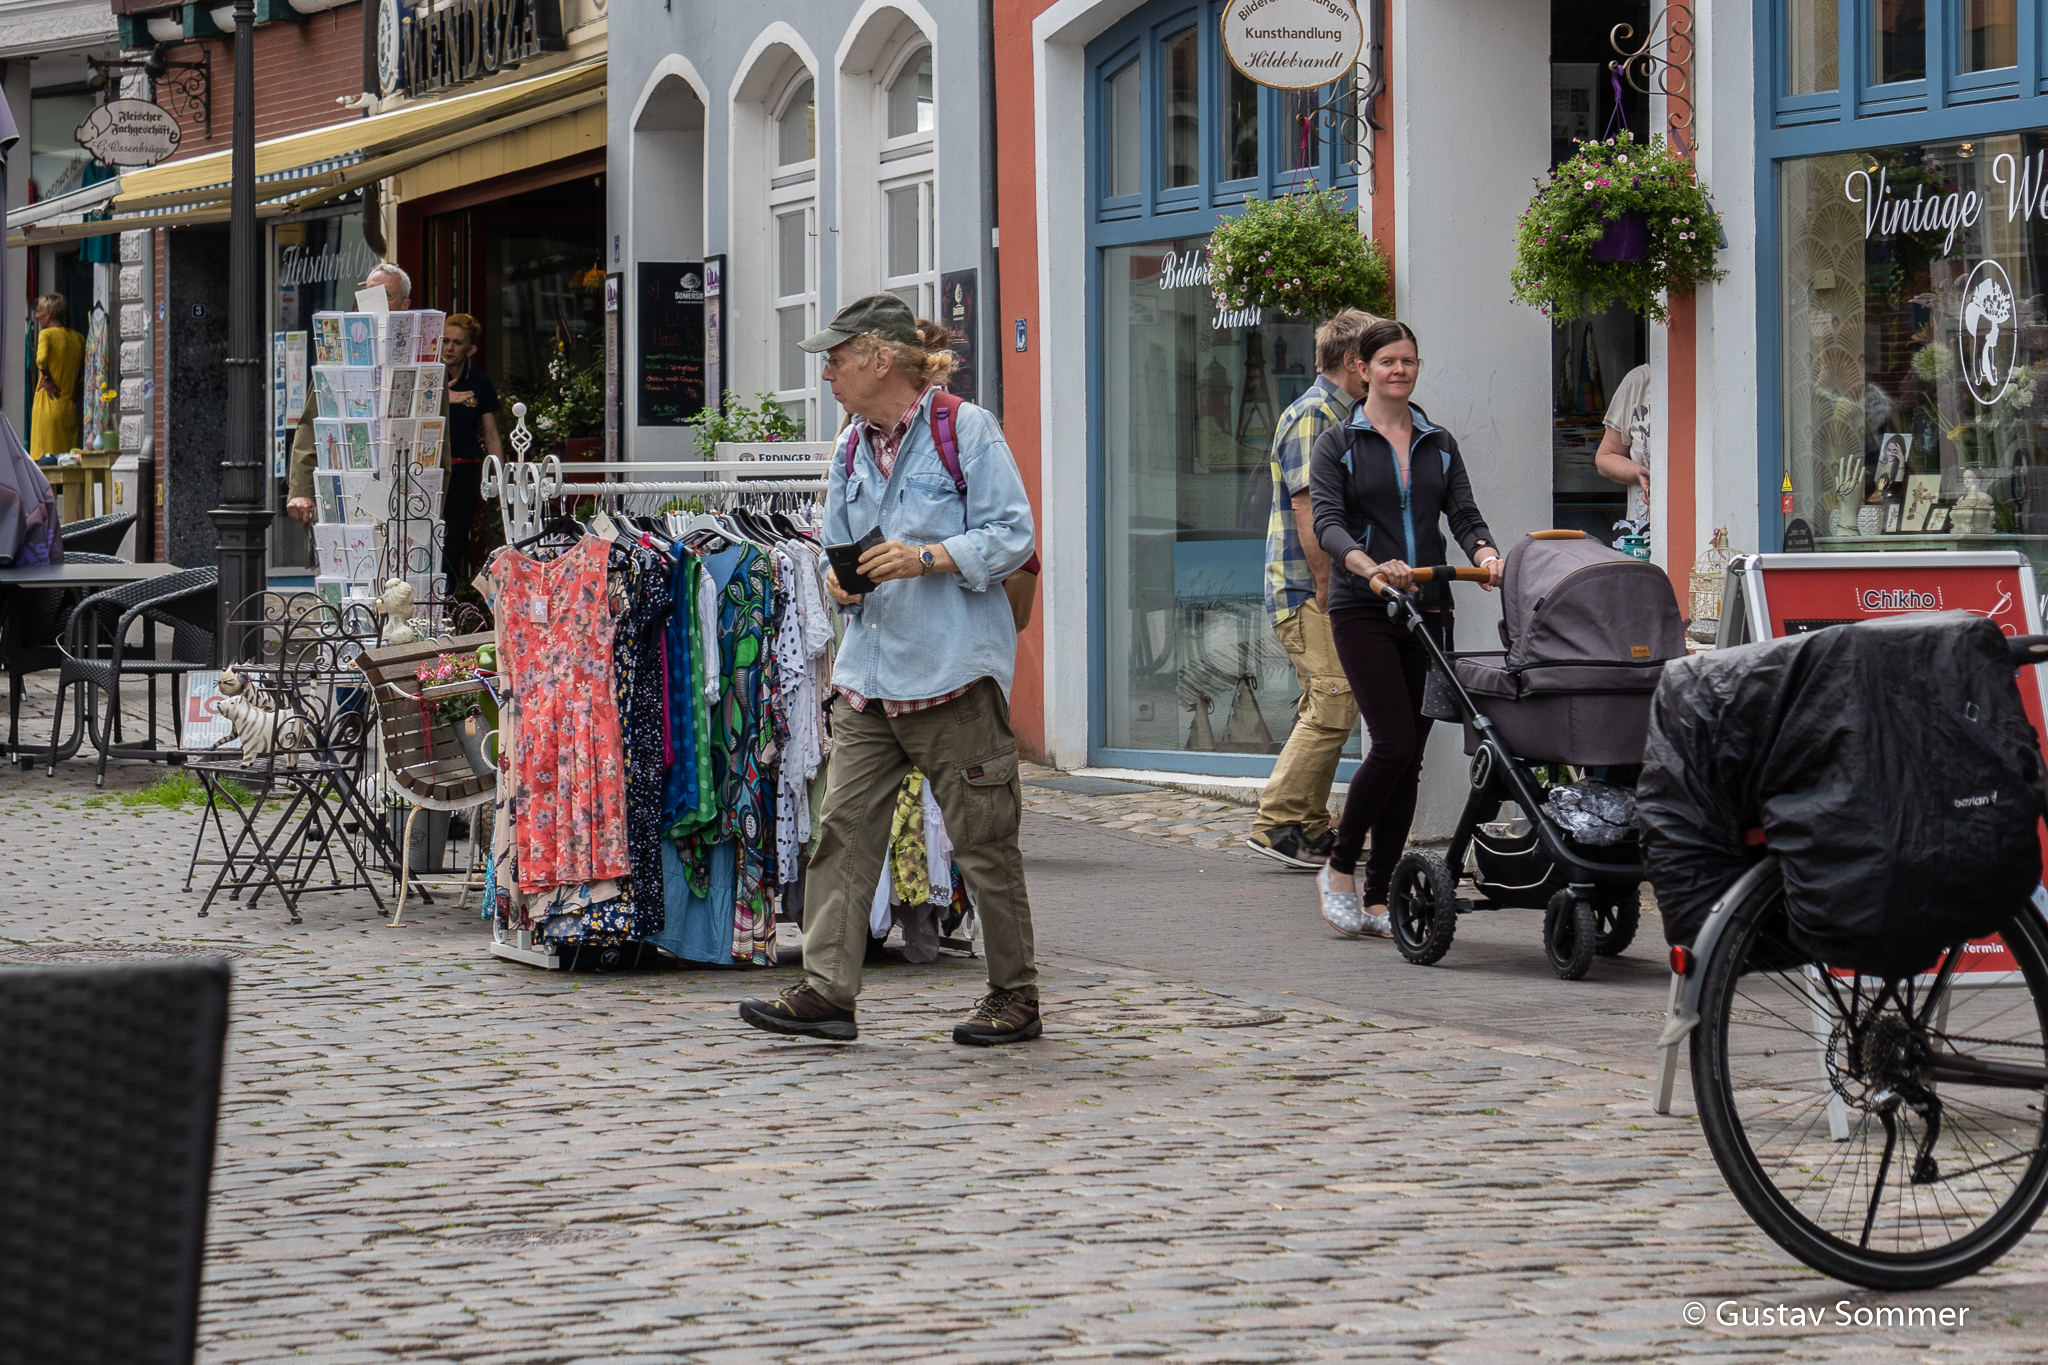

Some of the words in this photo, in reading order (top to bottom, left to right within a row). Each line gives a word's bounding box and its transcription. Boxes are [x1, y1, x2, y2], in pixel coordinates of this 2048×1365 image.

[1245, 27, 1342, 43] Kunsthandlung
[402, 0, 543, 99] MENDOZA
[1244, 50, 1343, 69] Hildebrandt
[118, 111, 162, 124] Fleischer
[111, 124, 170, 137] Fachgeschäft
[1844, 166, 1984, 257] Vintage
[282, 242, 353, 287] Fleischerei
[195, 306, 202, 316] 3
[1864, 589, 1936, 609] Chikho
